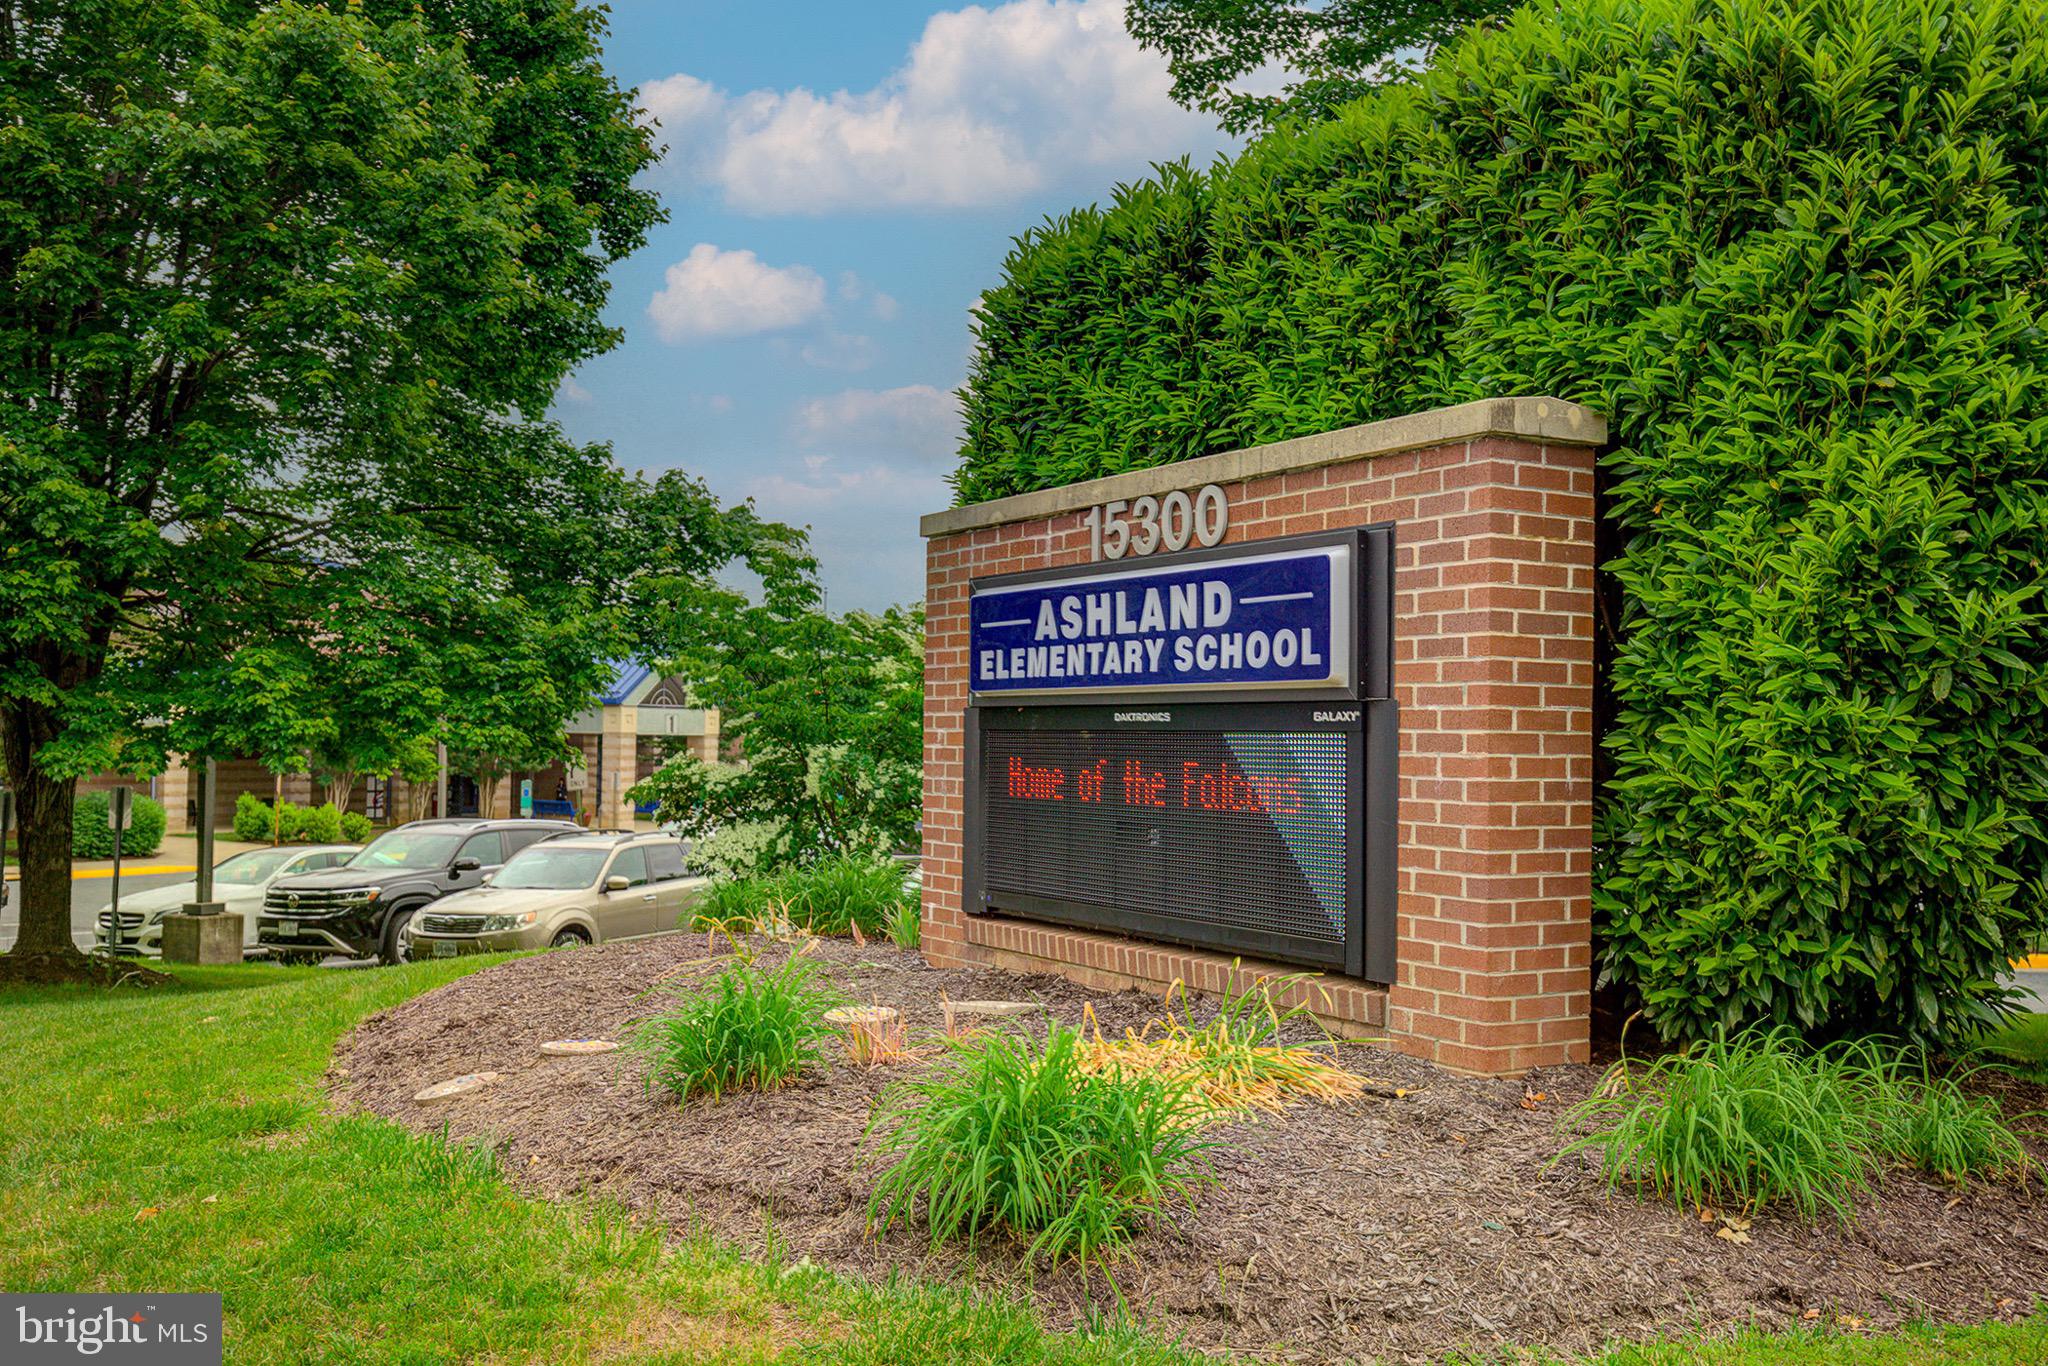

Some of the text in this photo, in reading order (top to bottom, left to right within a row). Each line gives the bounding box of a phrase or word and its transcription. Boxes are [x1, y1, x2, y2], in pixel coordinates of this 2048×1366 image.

[1084, 484, 1229, 562] 15300
[1034, 580, 1233, 641] ASHLAND
[979, 628, 1322, 681] ELEMENTARY SCHOOL
[1114, 712, 1171, 722] DAKTRONICS
[1313, 711, 1356, 722] GALAXY
[1009, 756, 1302, 814] Home of the Falcons
